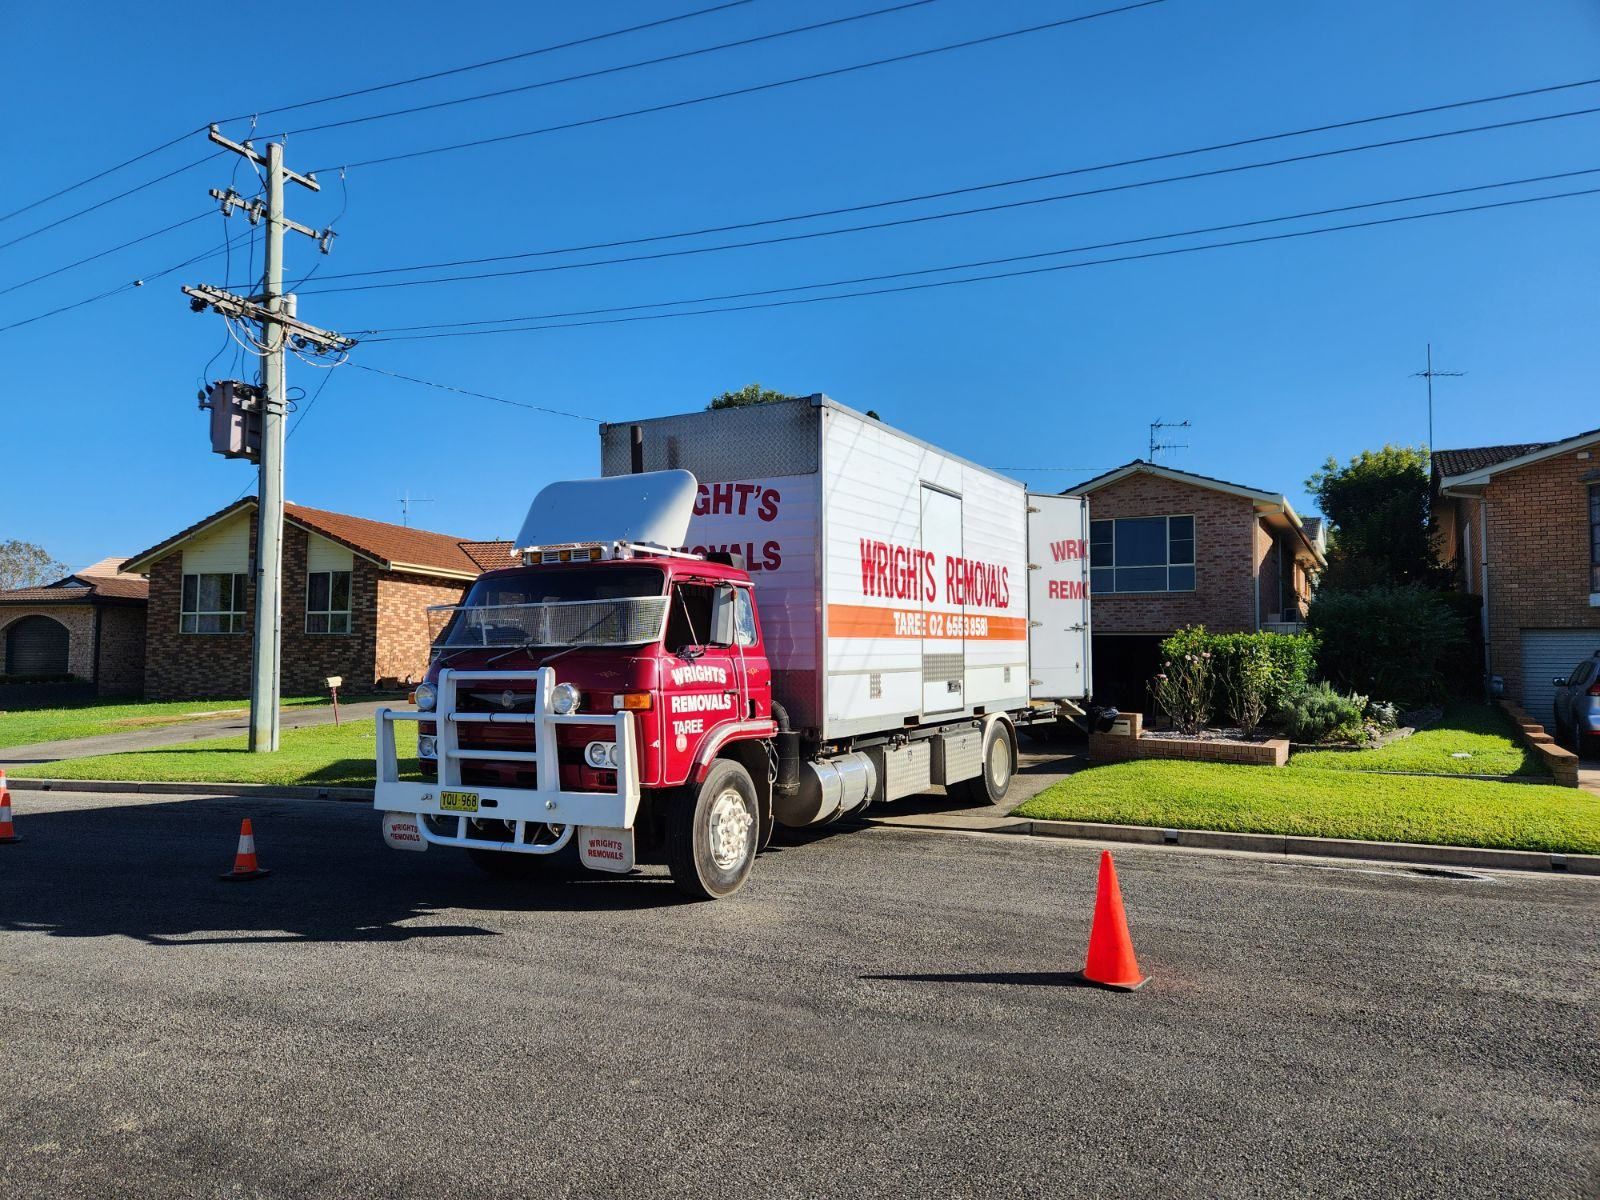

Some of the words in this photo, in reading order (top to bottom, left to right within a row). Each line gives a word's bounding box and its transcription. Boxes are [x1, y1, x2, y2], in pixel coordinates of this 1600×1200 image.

[693, 483, 781, 522] GHT'S
[859, 537, 937, 604] WRIGHTS
[946, 555, 1010, 609] REMOVALS
[893, 611, 927, 636] TAREE
[929, 614, 944, 637] 02
[671, 665, 727, 686] WRIGHTS
[671, 693, 732, 714] REMOVALS
[672, 718, 704, 735] TAREE
[391, 823, 418, 834] WRIGHTS
[587, 849, 624, 861] REMOVALS
[588, 839, 623, 851] WRIGHTS
